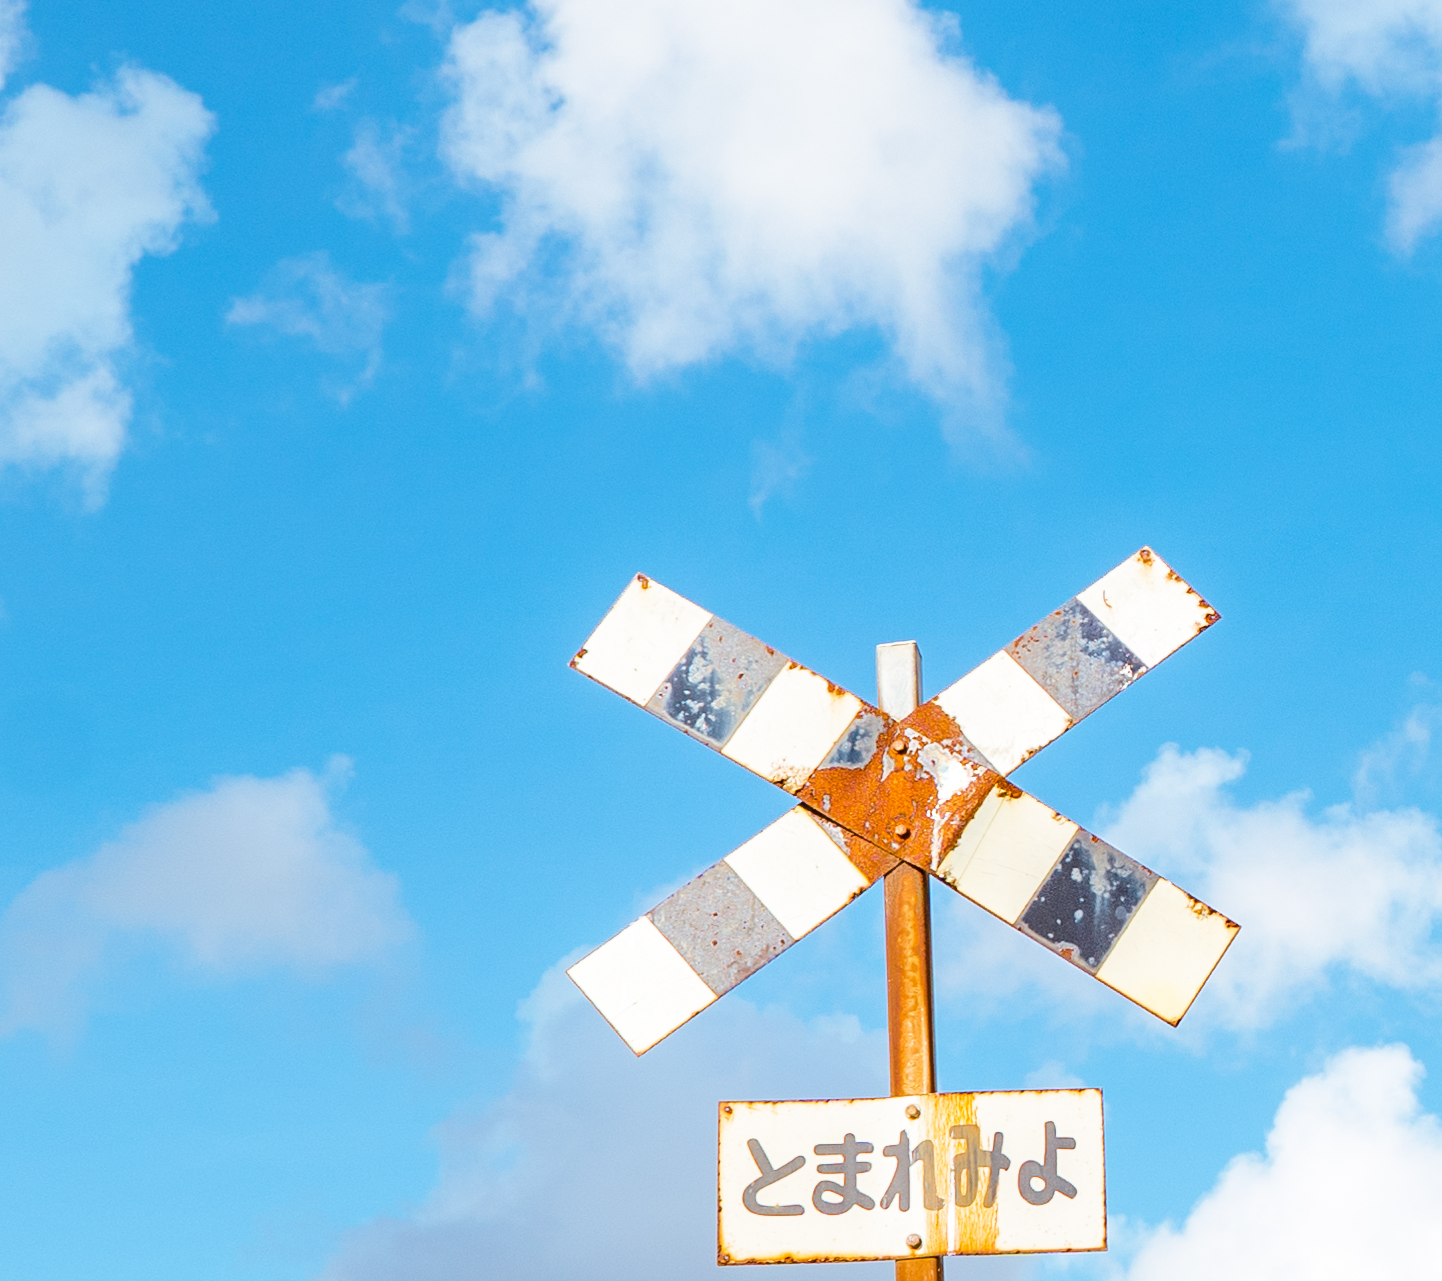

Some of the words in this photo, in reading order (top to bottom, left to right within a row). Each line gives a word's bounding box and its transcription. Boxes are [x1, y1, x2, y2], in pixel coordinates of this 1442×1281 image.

[741, 1119, 1078, 1217] とまれみよ
